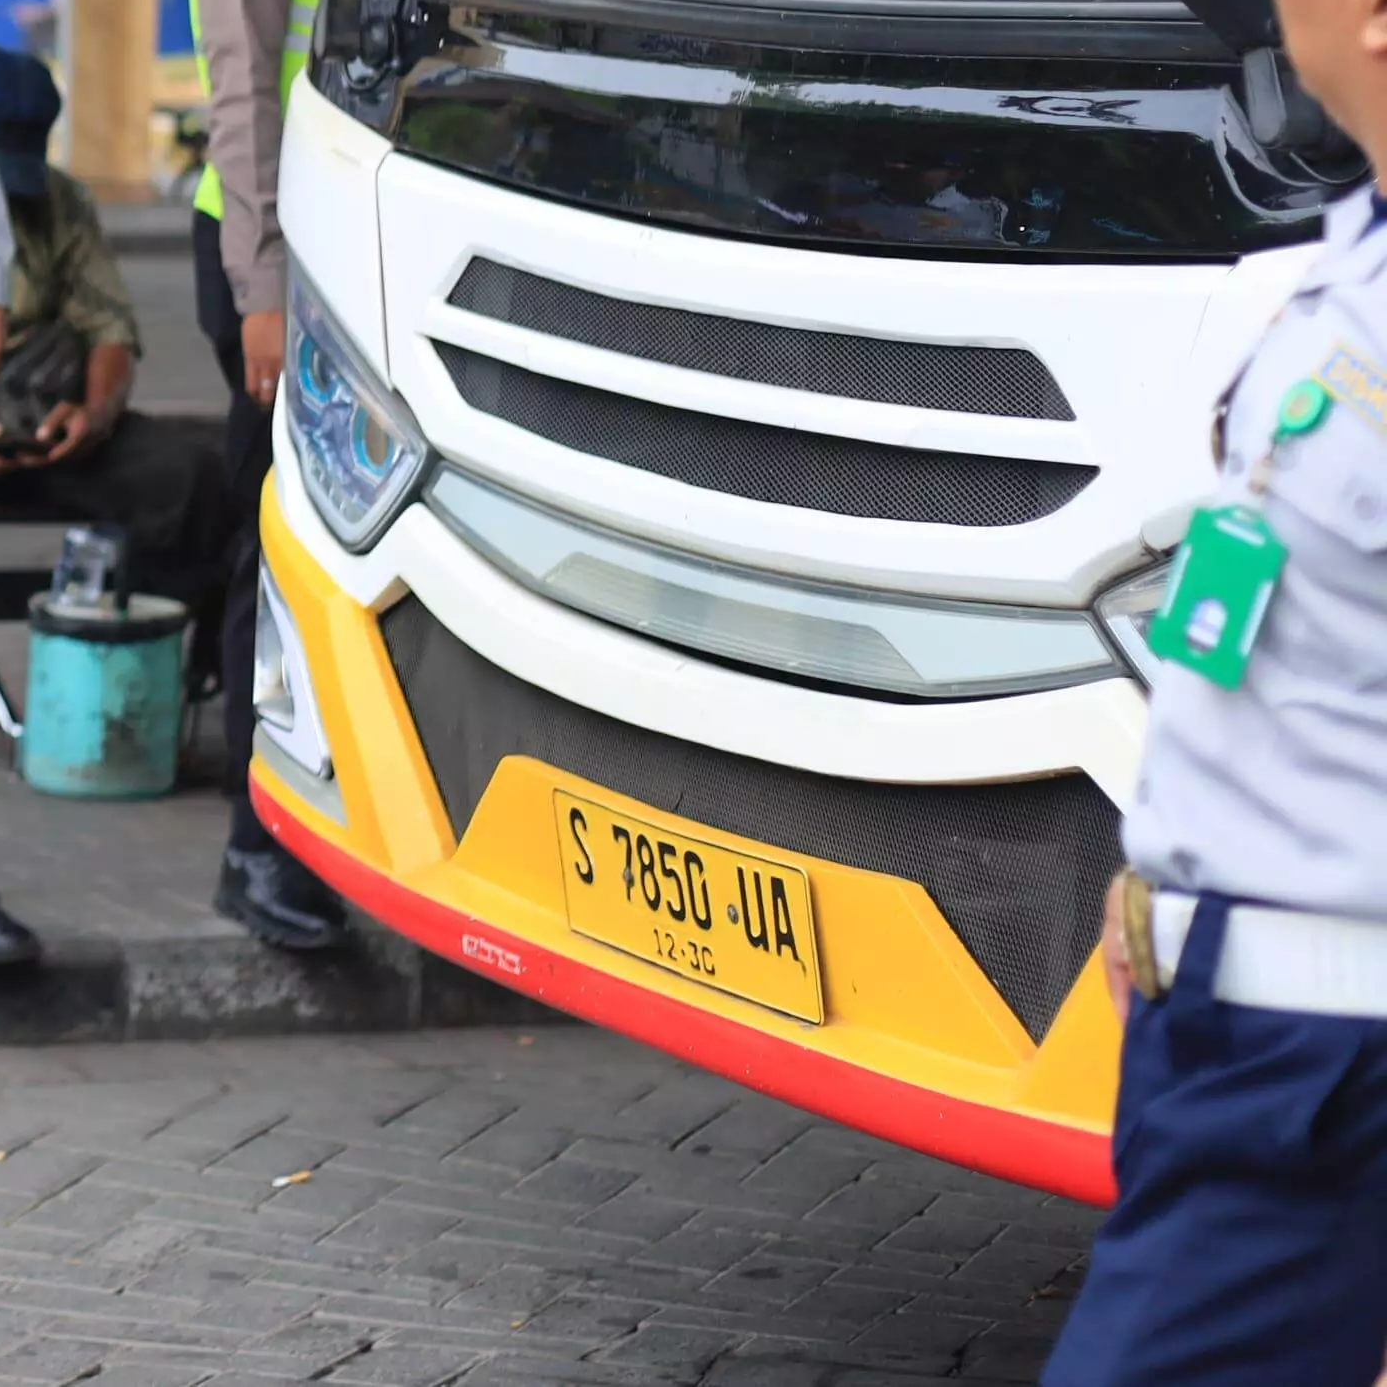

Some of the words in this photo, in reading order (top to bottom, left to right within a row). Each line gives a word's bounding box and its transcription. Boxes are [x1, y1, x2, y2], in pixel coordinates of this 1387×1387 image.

[569, 807, 594, 885] S
[611, 823, 712, 931] 7850
[736, 866, 800, 962] UA
